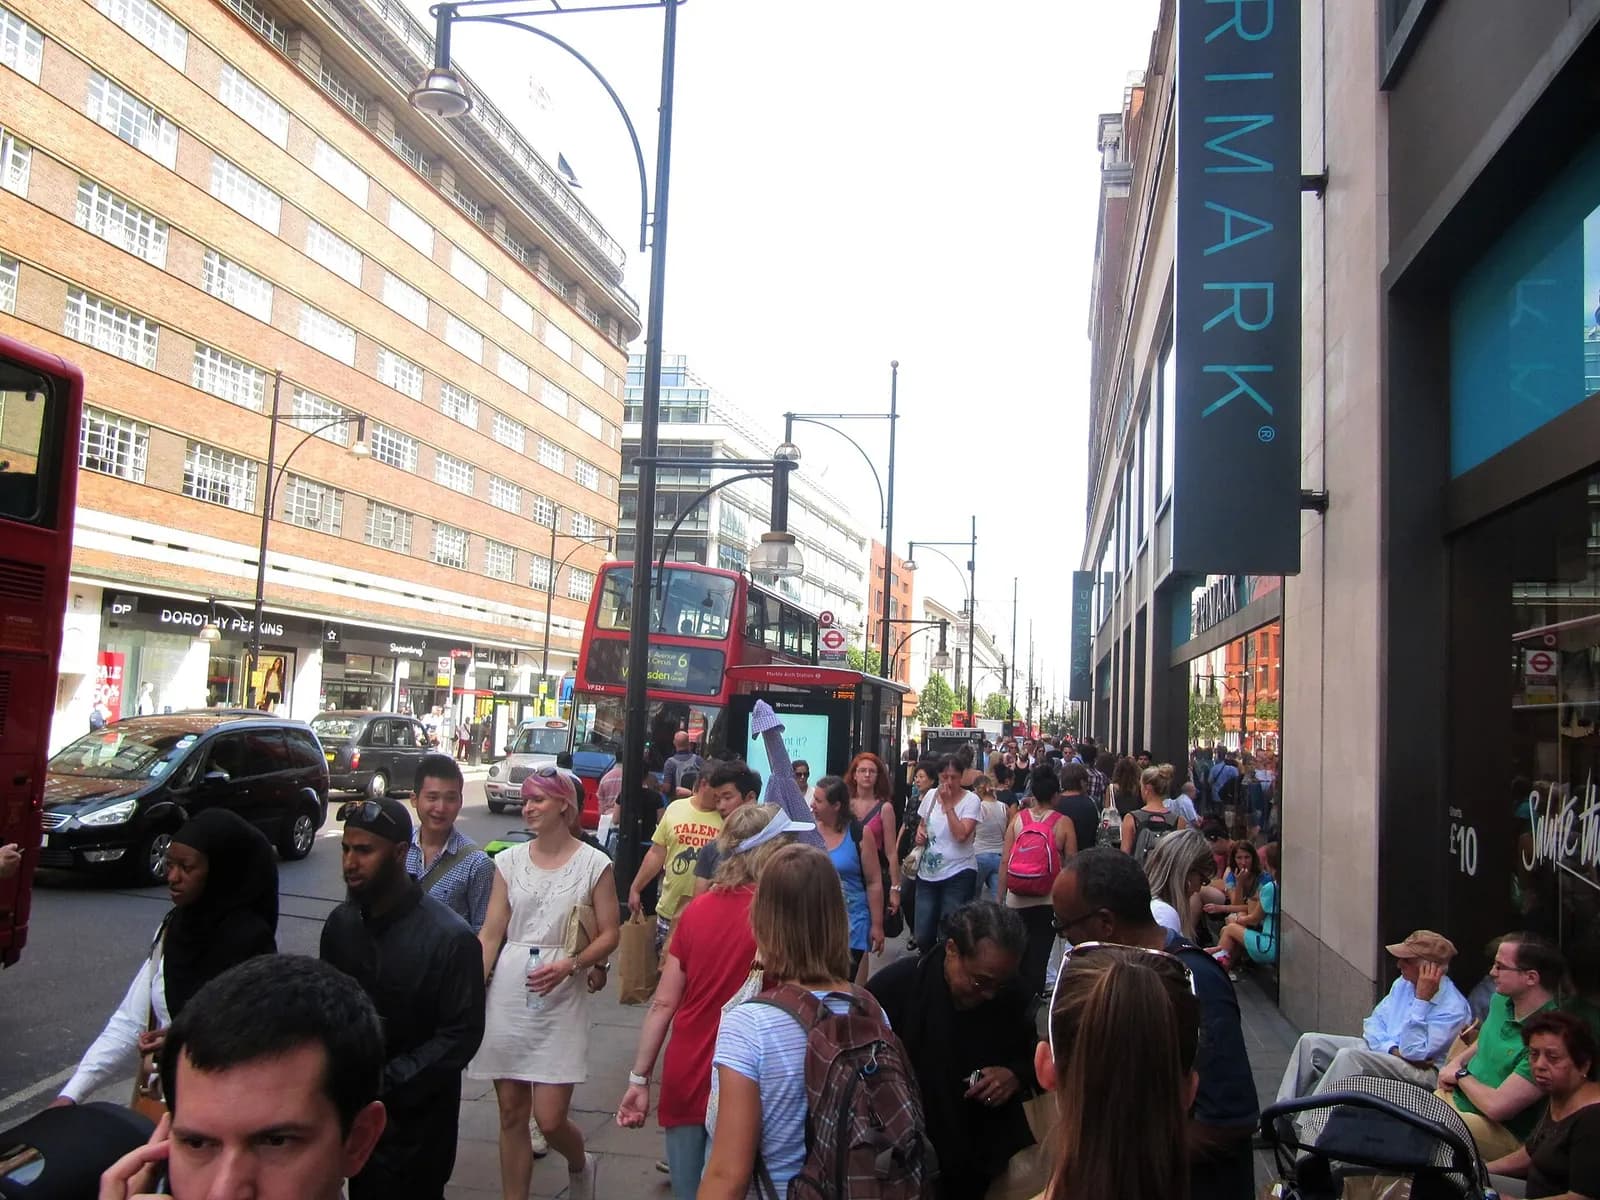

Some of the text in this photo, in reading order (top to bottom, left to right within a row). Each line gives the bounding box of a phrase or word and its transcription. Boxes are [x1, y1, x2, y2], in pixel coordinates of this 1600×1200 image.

[112, 604, 132, 614] DP
[161, 609, 229, 630] DOROTHY
[678, 653, 688, 668] 6
[1522, 783, 1578, 872] Salute
[1449, 822, 1477, 876] £10
